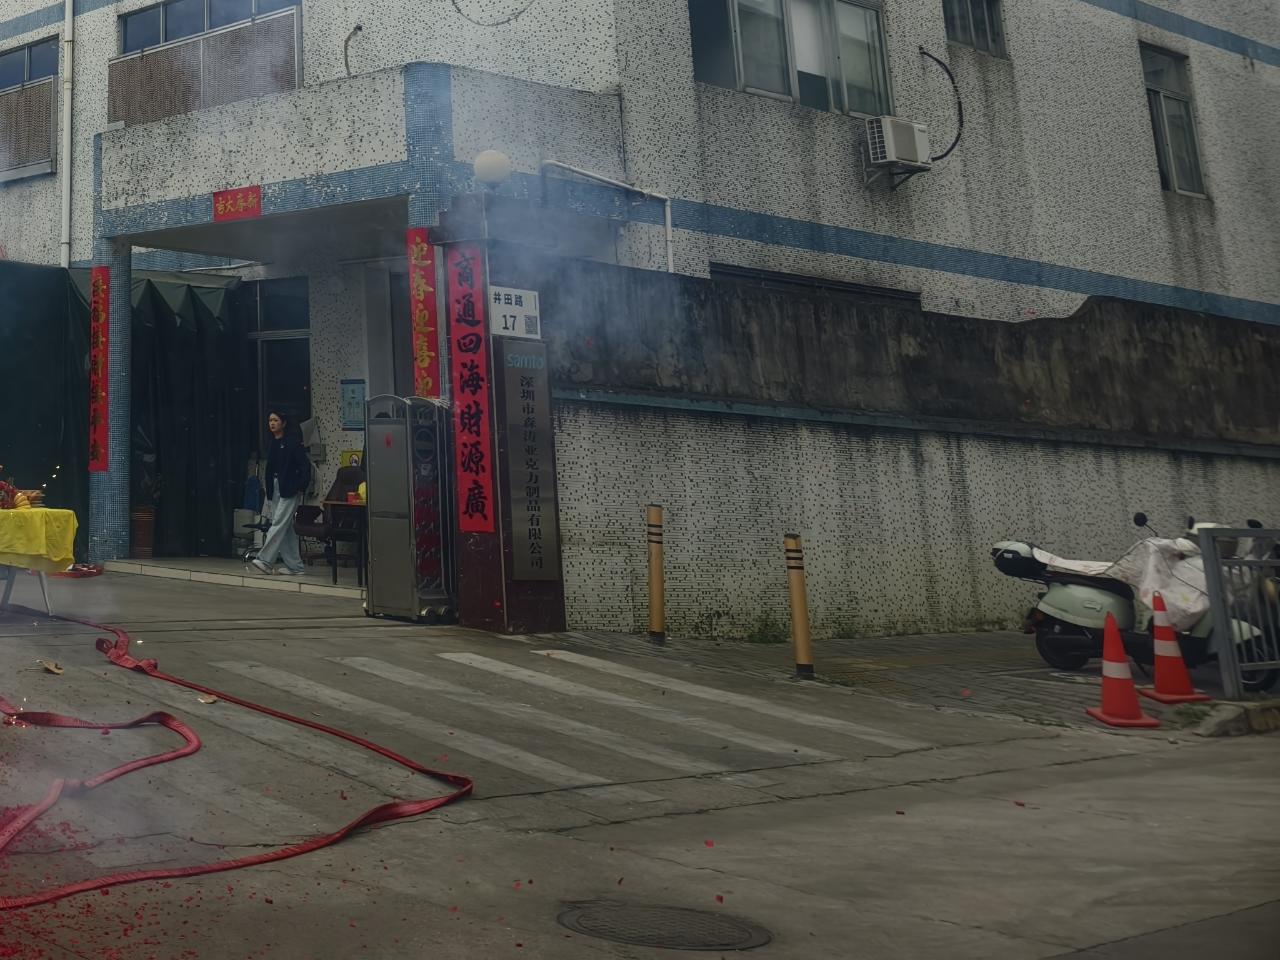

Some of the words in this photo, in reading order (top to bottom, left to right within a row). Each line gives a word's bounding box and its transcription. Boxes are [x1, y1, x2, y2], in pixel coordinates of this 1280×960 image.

[493, 291, 524, 307] 井田路
[502, 314, 517, 331] 17
